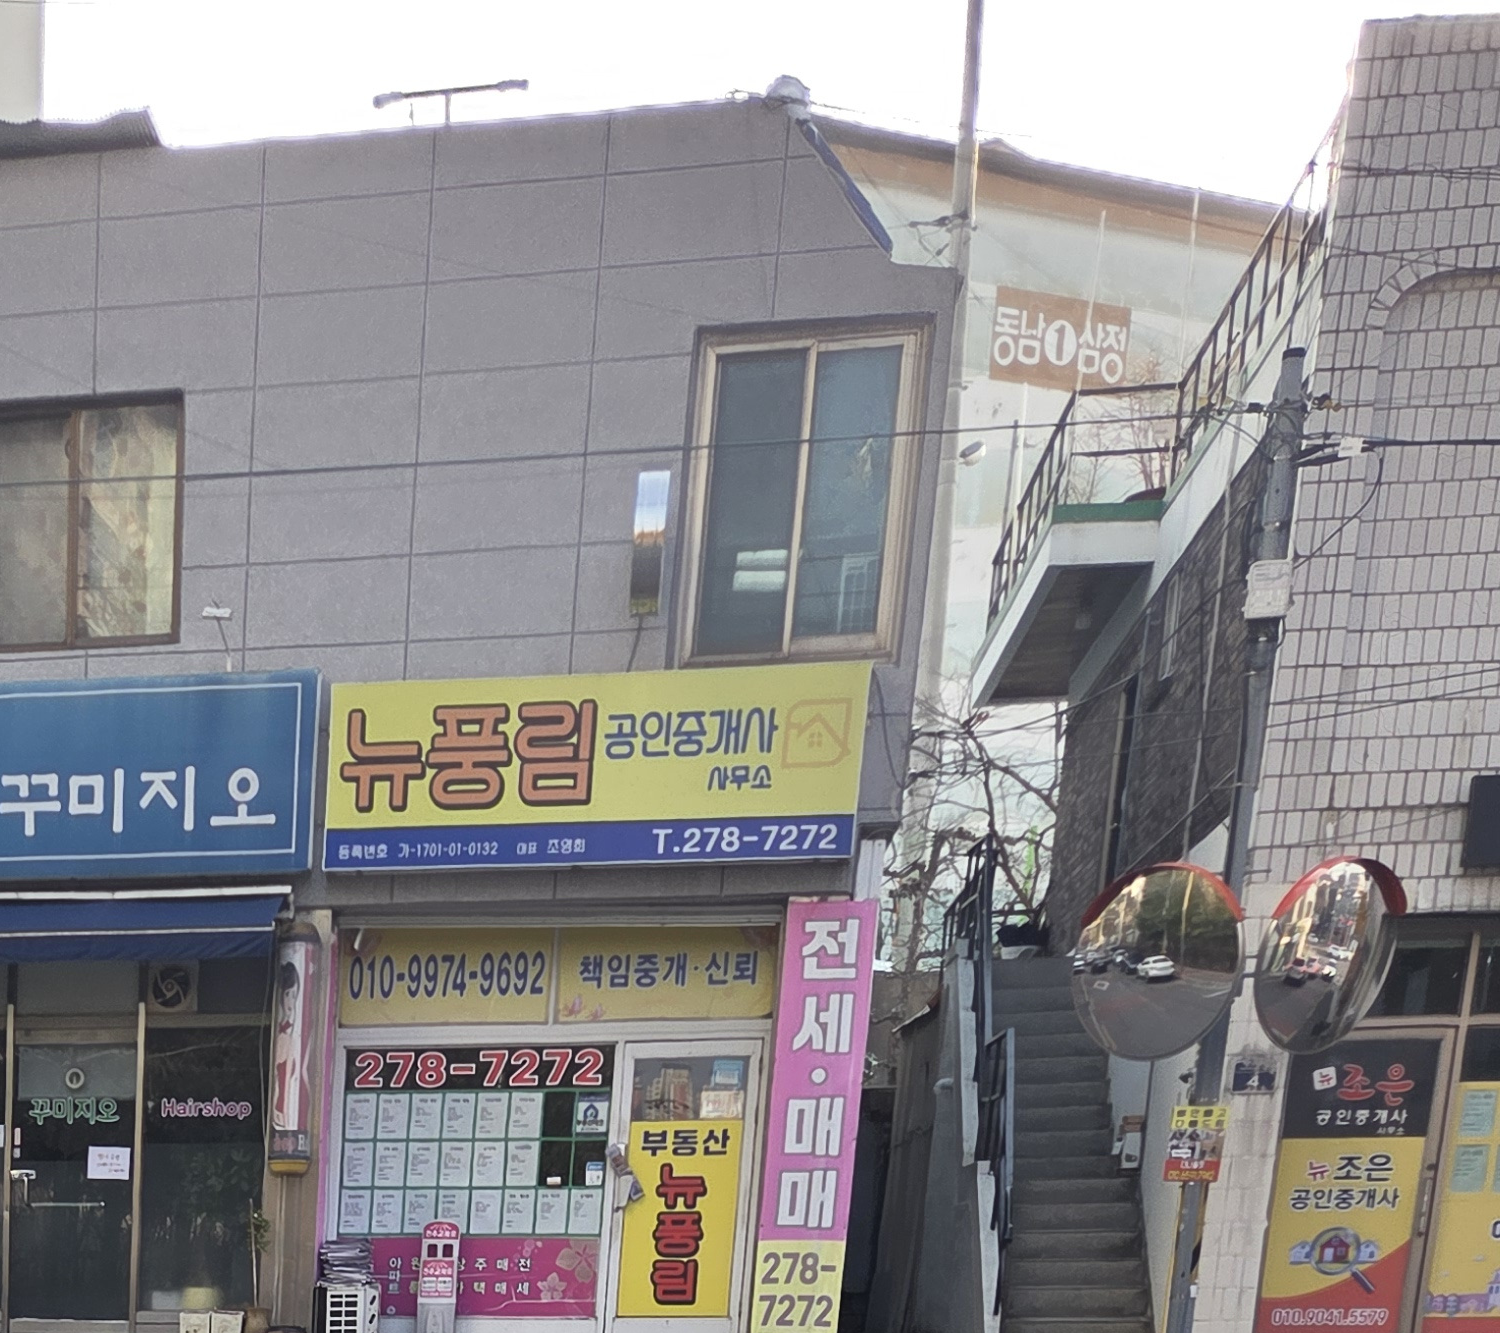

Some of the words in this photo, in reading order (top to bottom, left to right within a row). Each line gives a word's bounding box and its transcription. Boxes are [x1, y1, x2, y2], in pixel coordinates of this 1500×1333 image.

[340, 698, 598, 813] 뉴풍림
[604, 706, 778, 760] 공인중개사
[707, 764, 772, 792] 사무소
[338, 843, 388, 860] 등록번호
[516, 842, 537, 855] 대표
[651, 823, 838, 855] T.278-7272
[348, 950, 546, 1000] 010-9974-9692
[353, 1048, 604, 1089] 278-7272
[1336, 1063, 1415, 1107] 조은
[29, 1097, 120, 1125] 꾸미지오
[160, 1097, 251, 1120] Hairshop
[1316, 1109, 1408, 1126] 공인중개사
[641, 1128, 731, 1157] 부동산
[1289, 1187, 1400, 1211] 공인중개사
[651, 1163, 707, 1305] 뉴풍림
[759, 1294, 834, 1328] 7272
[1271, 1308, 1389, 1326] 010.9041.5579
